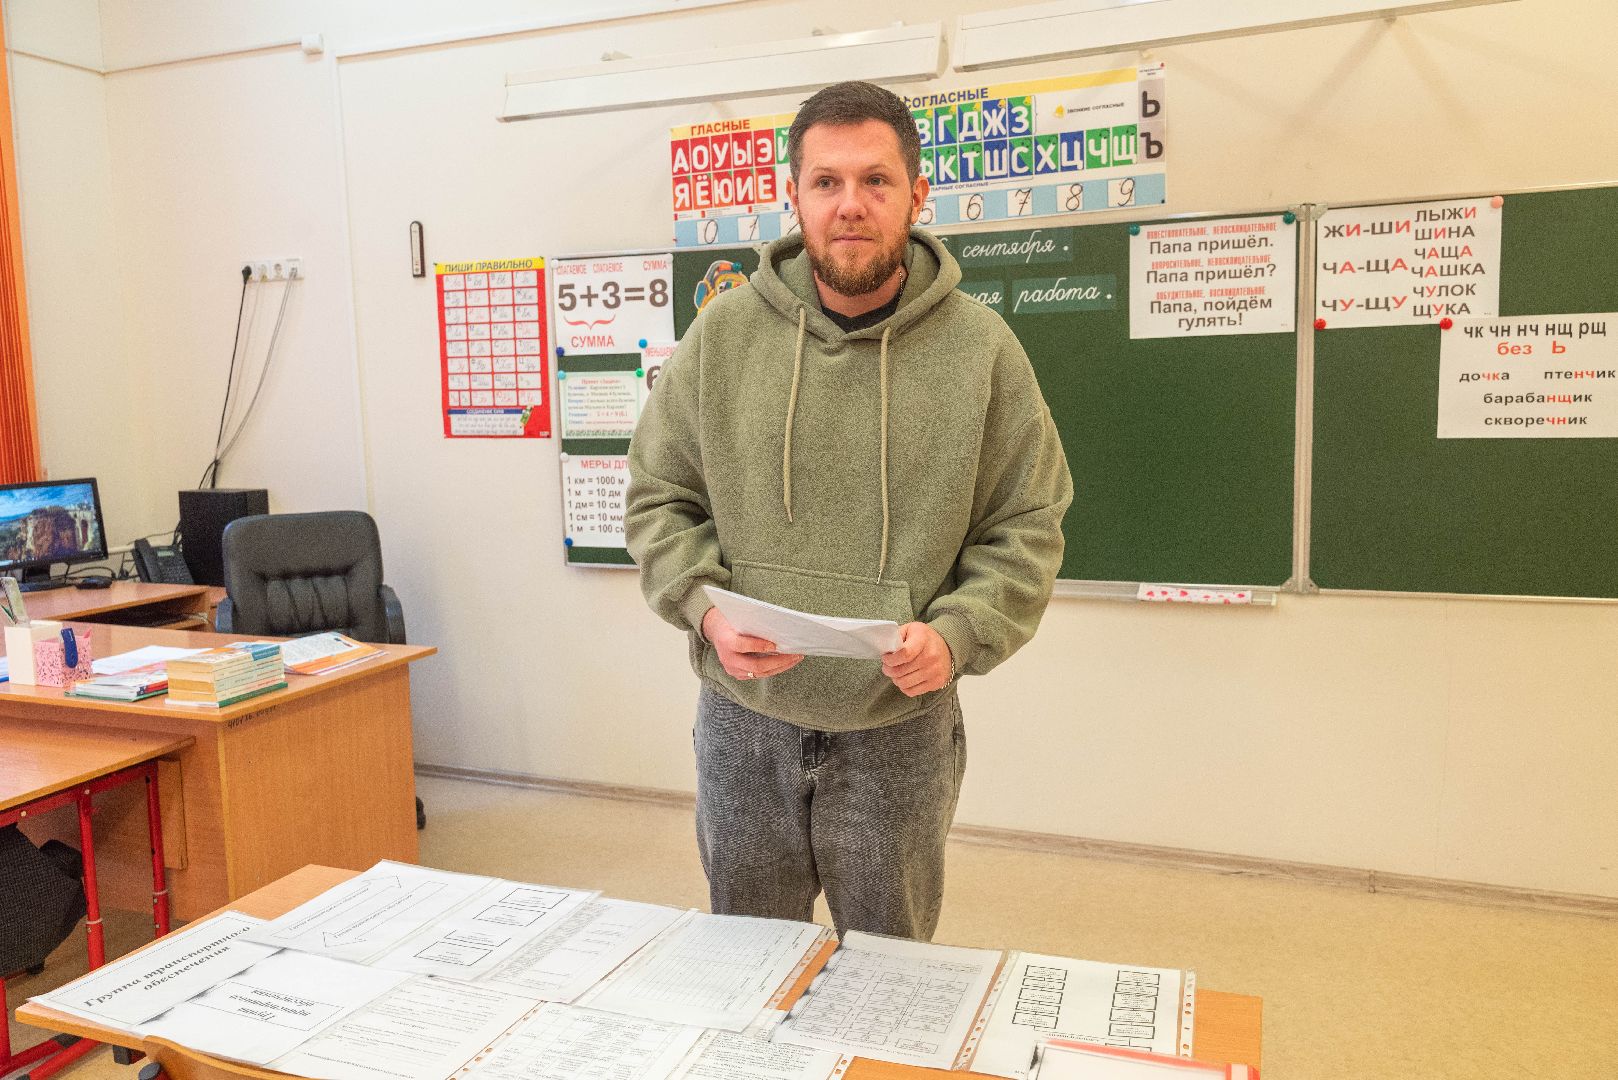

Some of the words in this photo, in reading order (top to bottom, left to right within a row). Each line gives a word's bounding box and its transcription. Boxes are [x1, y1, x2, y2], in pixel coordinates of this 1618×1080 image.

[691, 119, 750, 136] ГЛАСНЫЕ
[966, 193, 984, 221] 6
[1015, 188, 1032, 217] 7
[1065, 183, 1083, 212] 8
[1117, 177, 1136, 207] 9
[1414, 206, 1477, 223] ЛЫЖИ
[1323, 219, 1410, 239] ЖИ-ШИ
[1414, 225, 1475, 241] ШИНА
[1149, 240, 1192, 255] Папа
[1198, 234, 1274, 253] пришёл.
[1414, 244, 1473, 260] ЧАЩА
[444, 263, 473, 273] ПИШИ
[475, 259, 533, 271] ПРАВИЛЬНО
[643, 259, 667, 271] СУММА
[1322, 257, 1409, 275] ЧА-ЩА
[1411, 262, 1486, 278] ЧАШКА
[1146, 270, 1188, 284] Папа
[1194, 263, 1277, 284] пришёл?
[1412, 282, 1477, 298] ЧУЛОК
[1150, 300, 1198, 314] Папа,
[1203, 296, 1272, 312] пойдём
[1321, 295, 1408, 312] ЧУ-ЩУ
[1412, 302, 1471, 319] ЩУКА
[1178, 312, 1243, 331] гулять!
[571, 335, 615, 349] СУММА
[1497, 341, 1532, 356] без
[1459, 371, 1510, 383] дочка
[1544, 368, 1616, 380] птенчик
[1483, 392, 1593, 406] барабанщик
[1484, 415, 1588, 428] скворечник
[580, 460, 611, 470] МЕРЫ
[596, 476, 616, 484] 1000
[596, 488, 606, 497] 10
[597, 500, 607, 509] 10
[598, 513, 607, 521] 10
[598, 525, 613, 533] 100
[143, 945, 231, 991] обеспечения
[84, 976, 141, 1008] Группа
